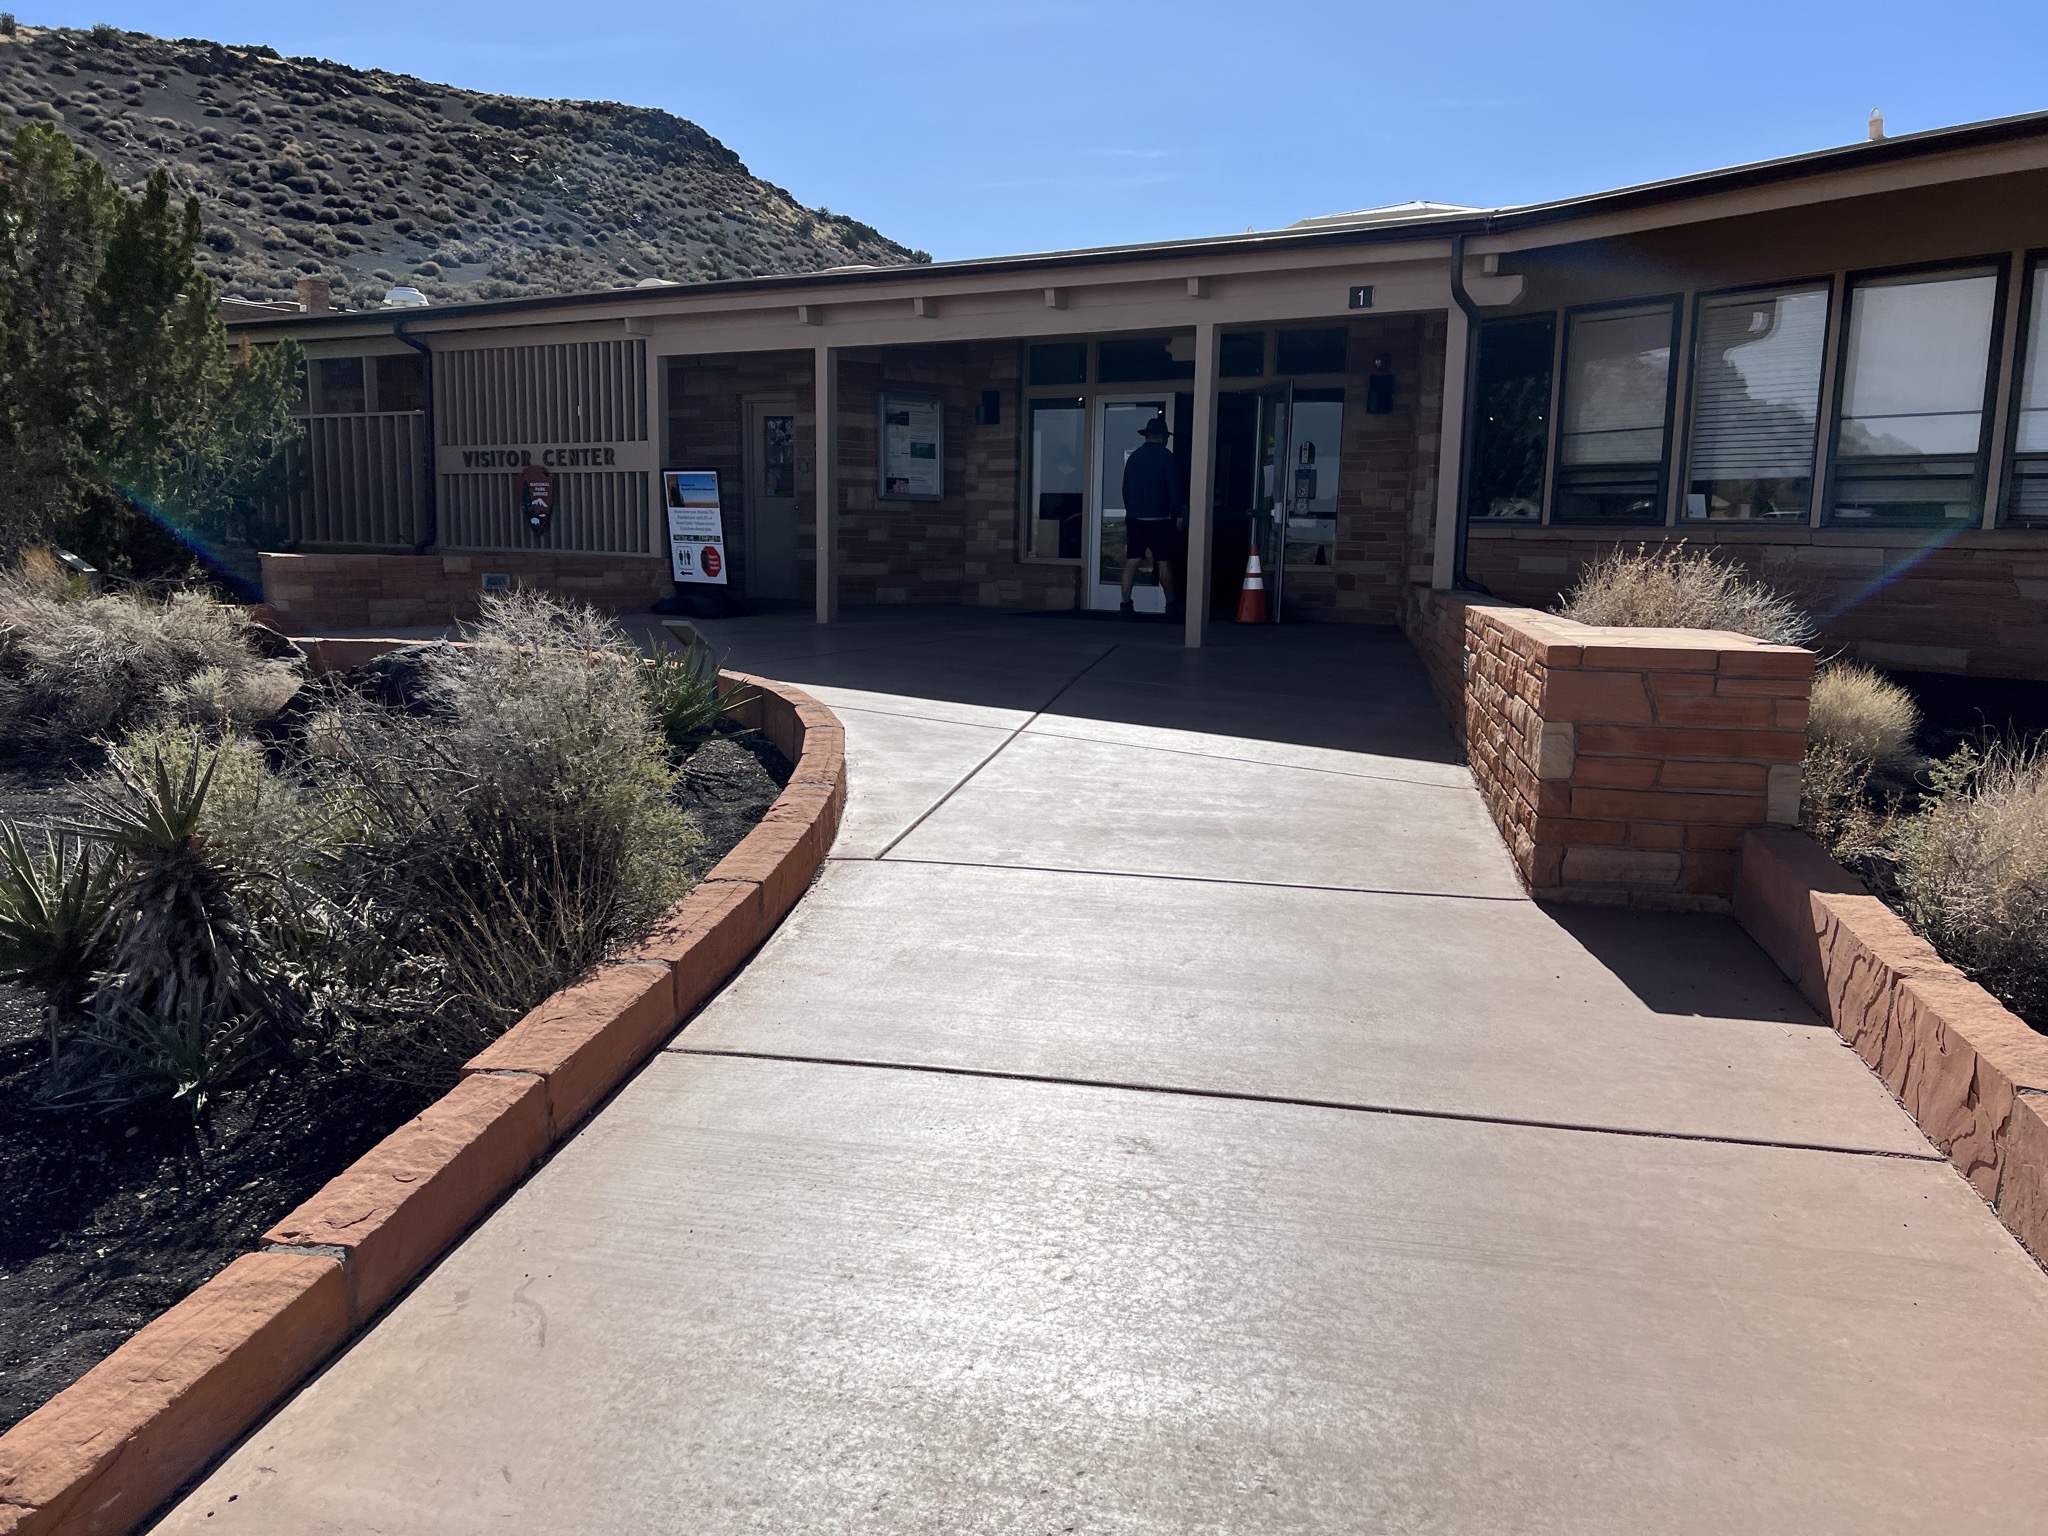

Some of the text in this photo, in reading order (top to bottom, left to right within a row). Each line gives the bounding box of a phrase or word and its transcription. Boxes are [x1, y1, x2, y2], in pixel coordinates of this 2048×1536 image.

[1358, 289, 1364, 306] 1
[462, 447, 616, 468] VISITOR CENTER
